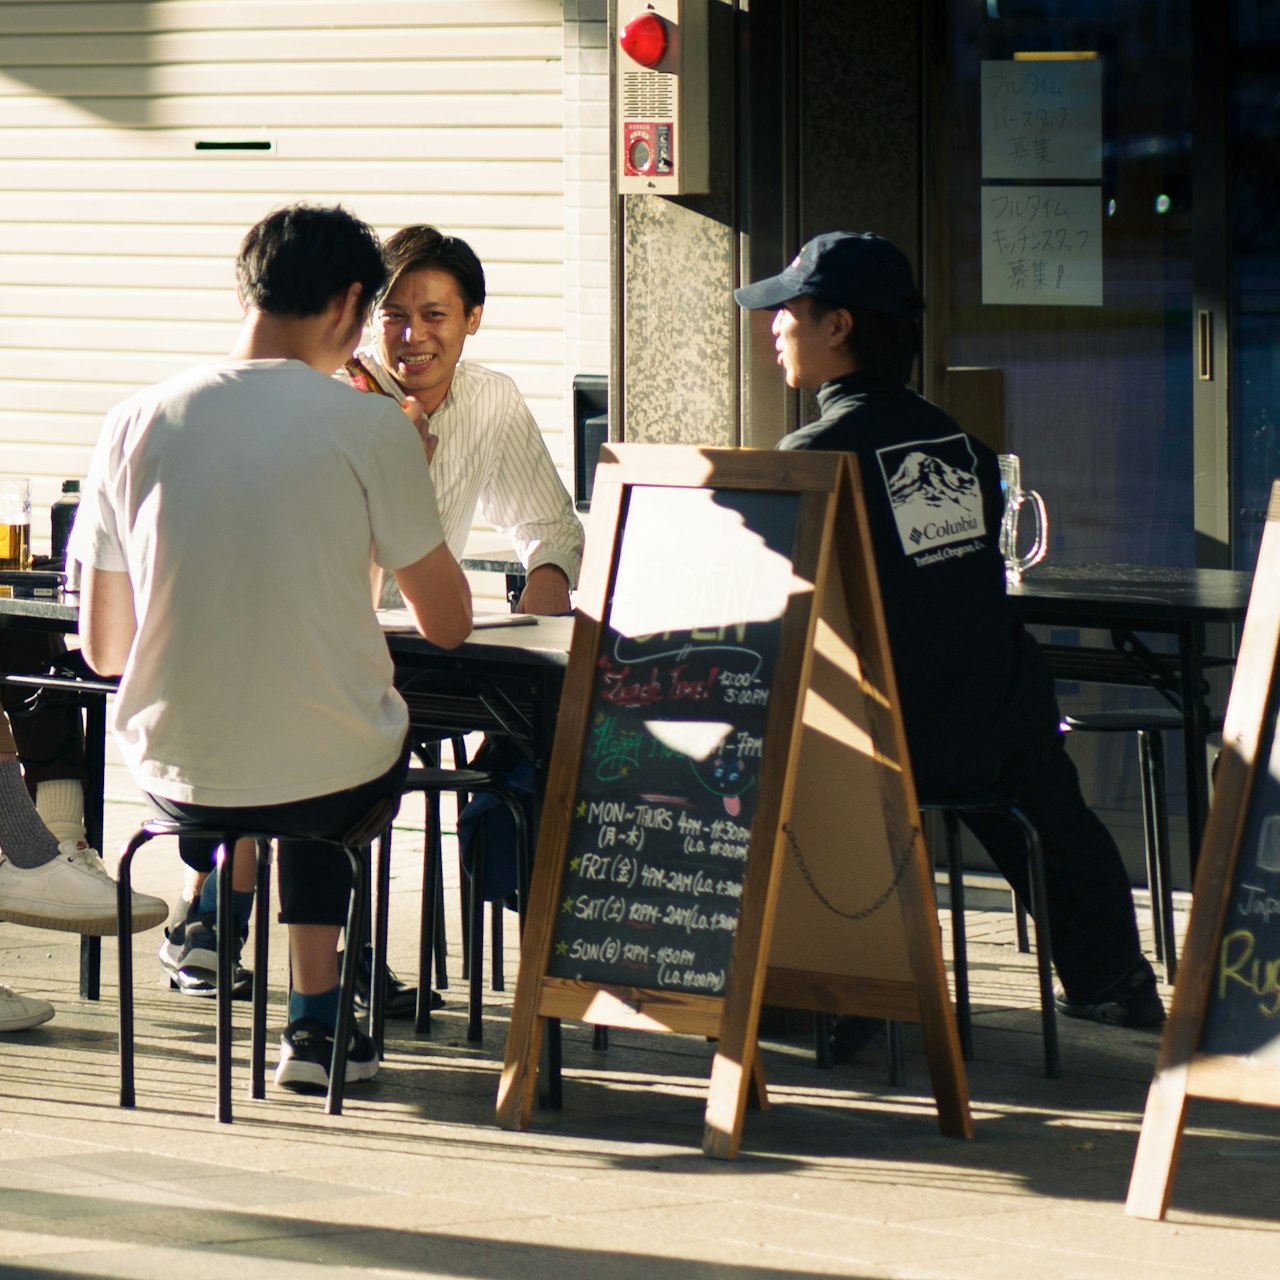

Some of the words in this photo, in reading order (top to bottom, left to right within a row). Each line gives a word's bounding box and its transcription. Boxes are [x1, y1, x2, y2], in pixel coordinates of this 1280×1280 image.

[987, 72, 1065, 99] フルタイム
[989, 195, 1072, 221] フルタイム
[990, 229, 1090, 255] キッチンスタッフ
